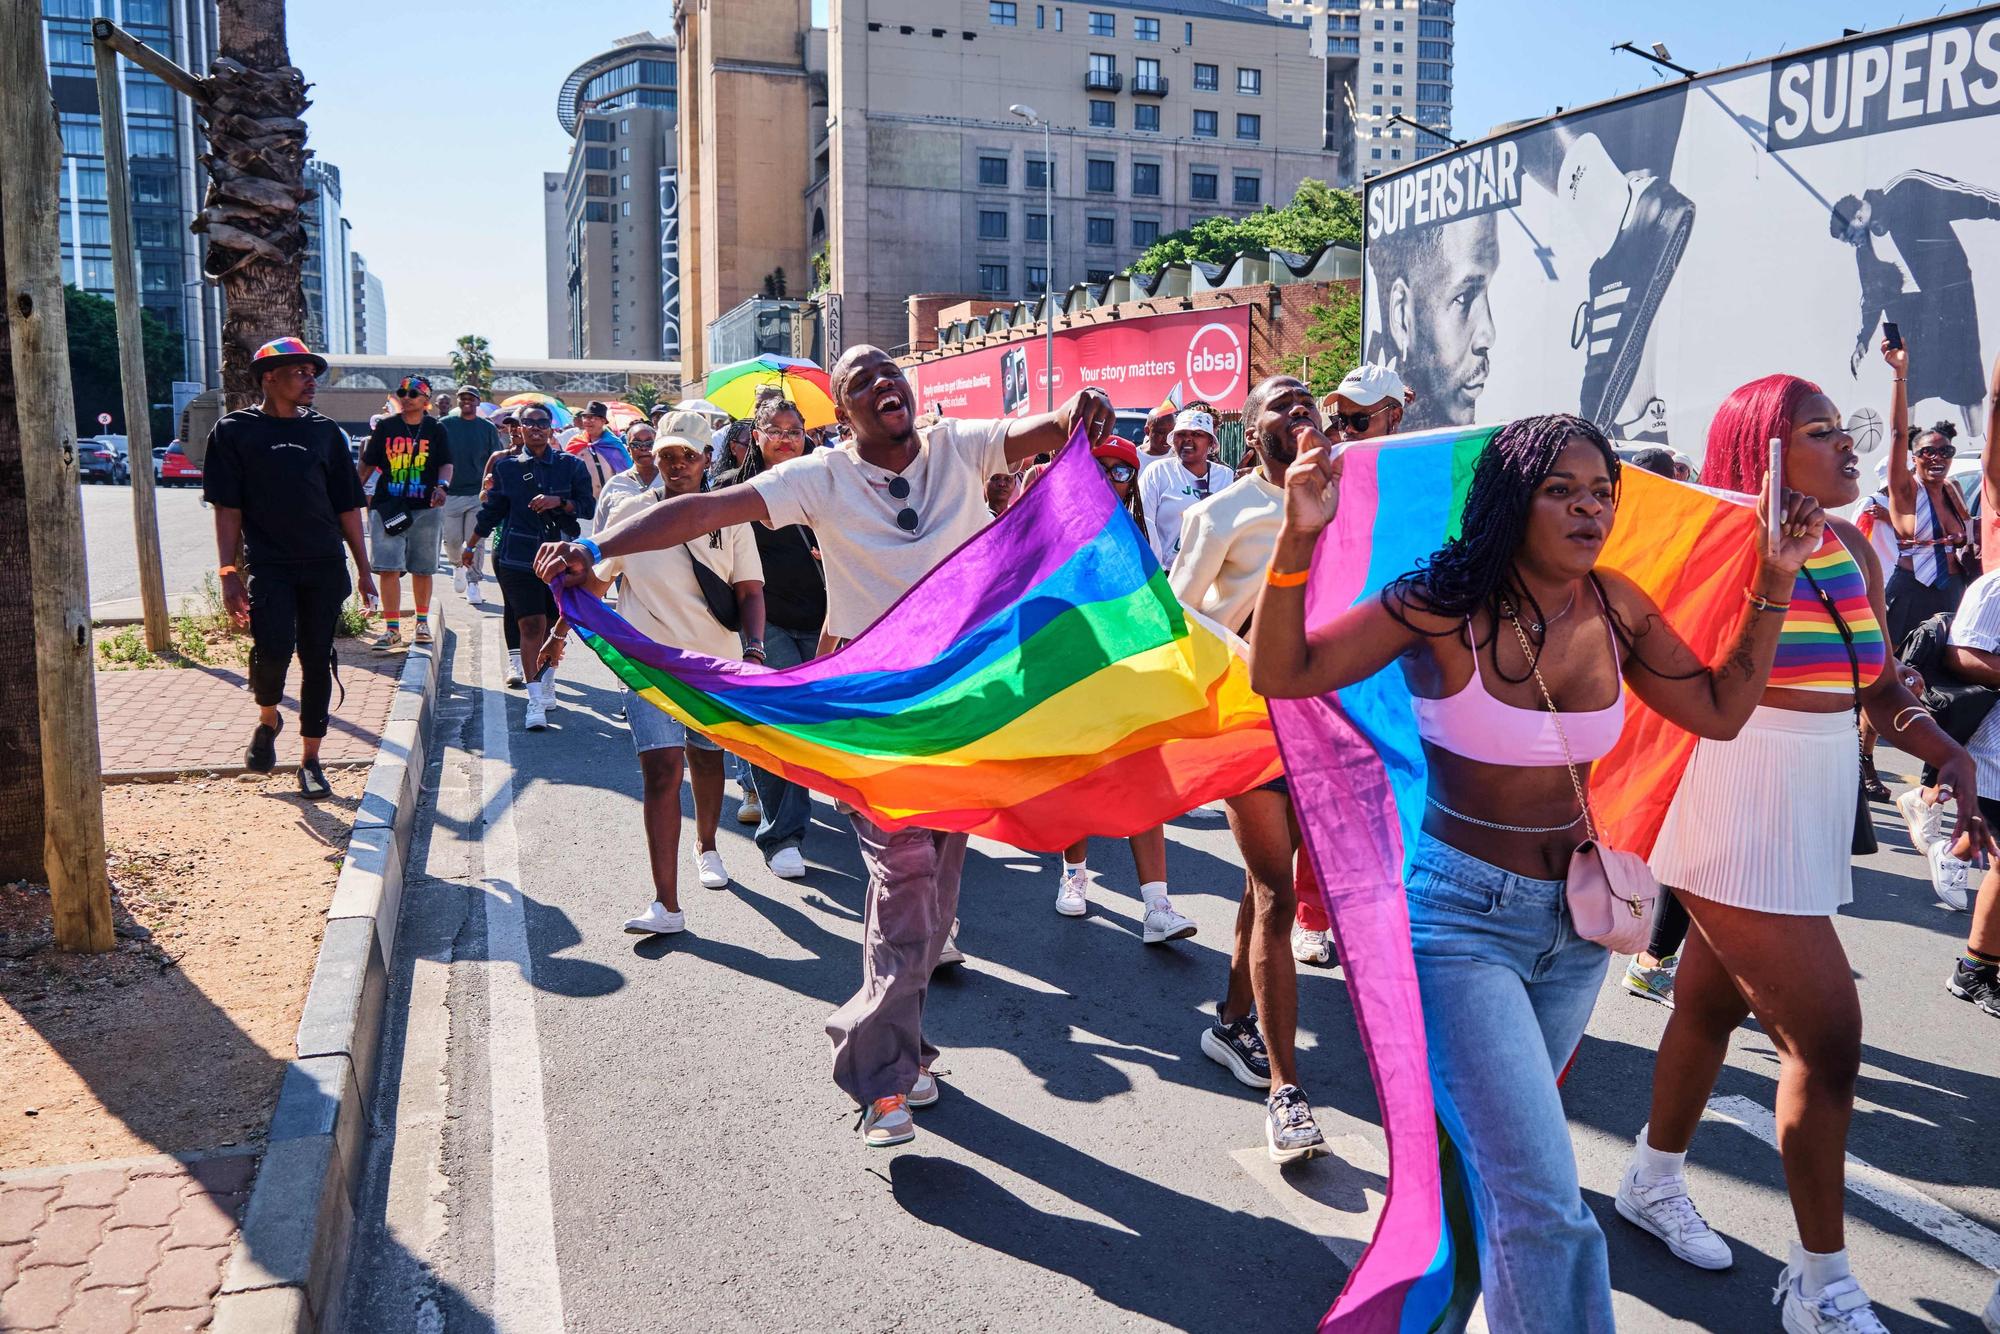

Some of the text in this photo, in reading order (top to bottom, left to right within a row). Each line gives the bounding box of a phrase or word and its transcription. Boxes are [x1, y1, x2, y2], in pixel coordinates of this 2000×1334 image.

[1775, 17, 2000, 140] SUPERS
[1368, 141, 1518, 239] SUPERSTAR
[660, 172, 680, 352] DAVINCI
[1192, 346, 1236, 372] absa
[1080, 360, 1176, 383] Your story matters
[385, 436, 430, 458] LOVE
[387, 452, 427, 472] WHO
[391, 468, 421, 485] YOU
[387, 482, 427, 498] WNT
